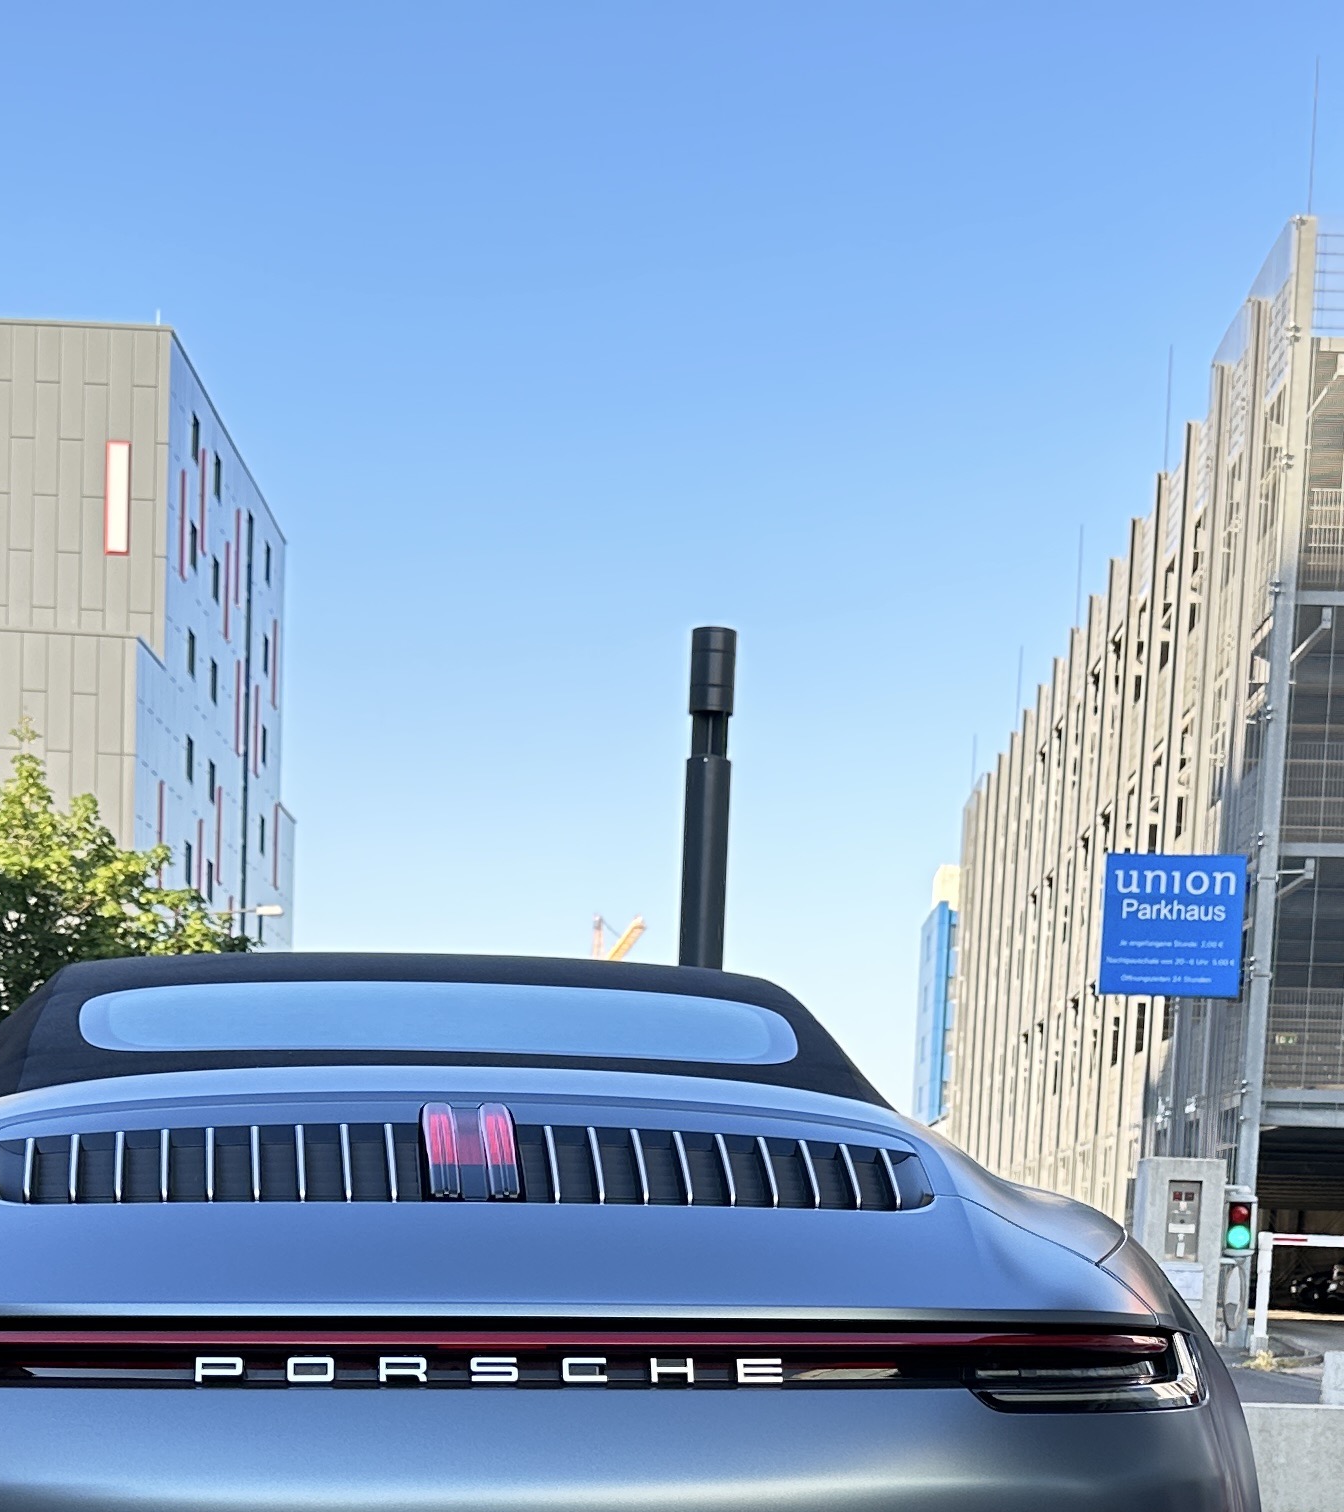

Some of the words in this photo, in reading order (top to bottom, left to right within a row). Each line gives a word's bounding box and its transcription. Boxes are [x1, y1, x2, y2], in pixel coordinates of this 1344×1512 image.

[1115, 868, 1236, 895] union
[1121, 898, 1226, 921] Parkhaus
[194, 1356, 784, 1383] PORSCHE
